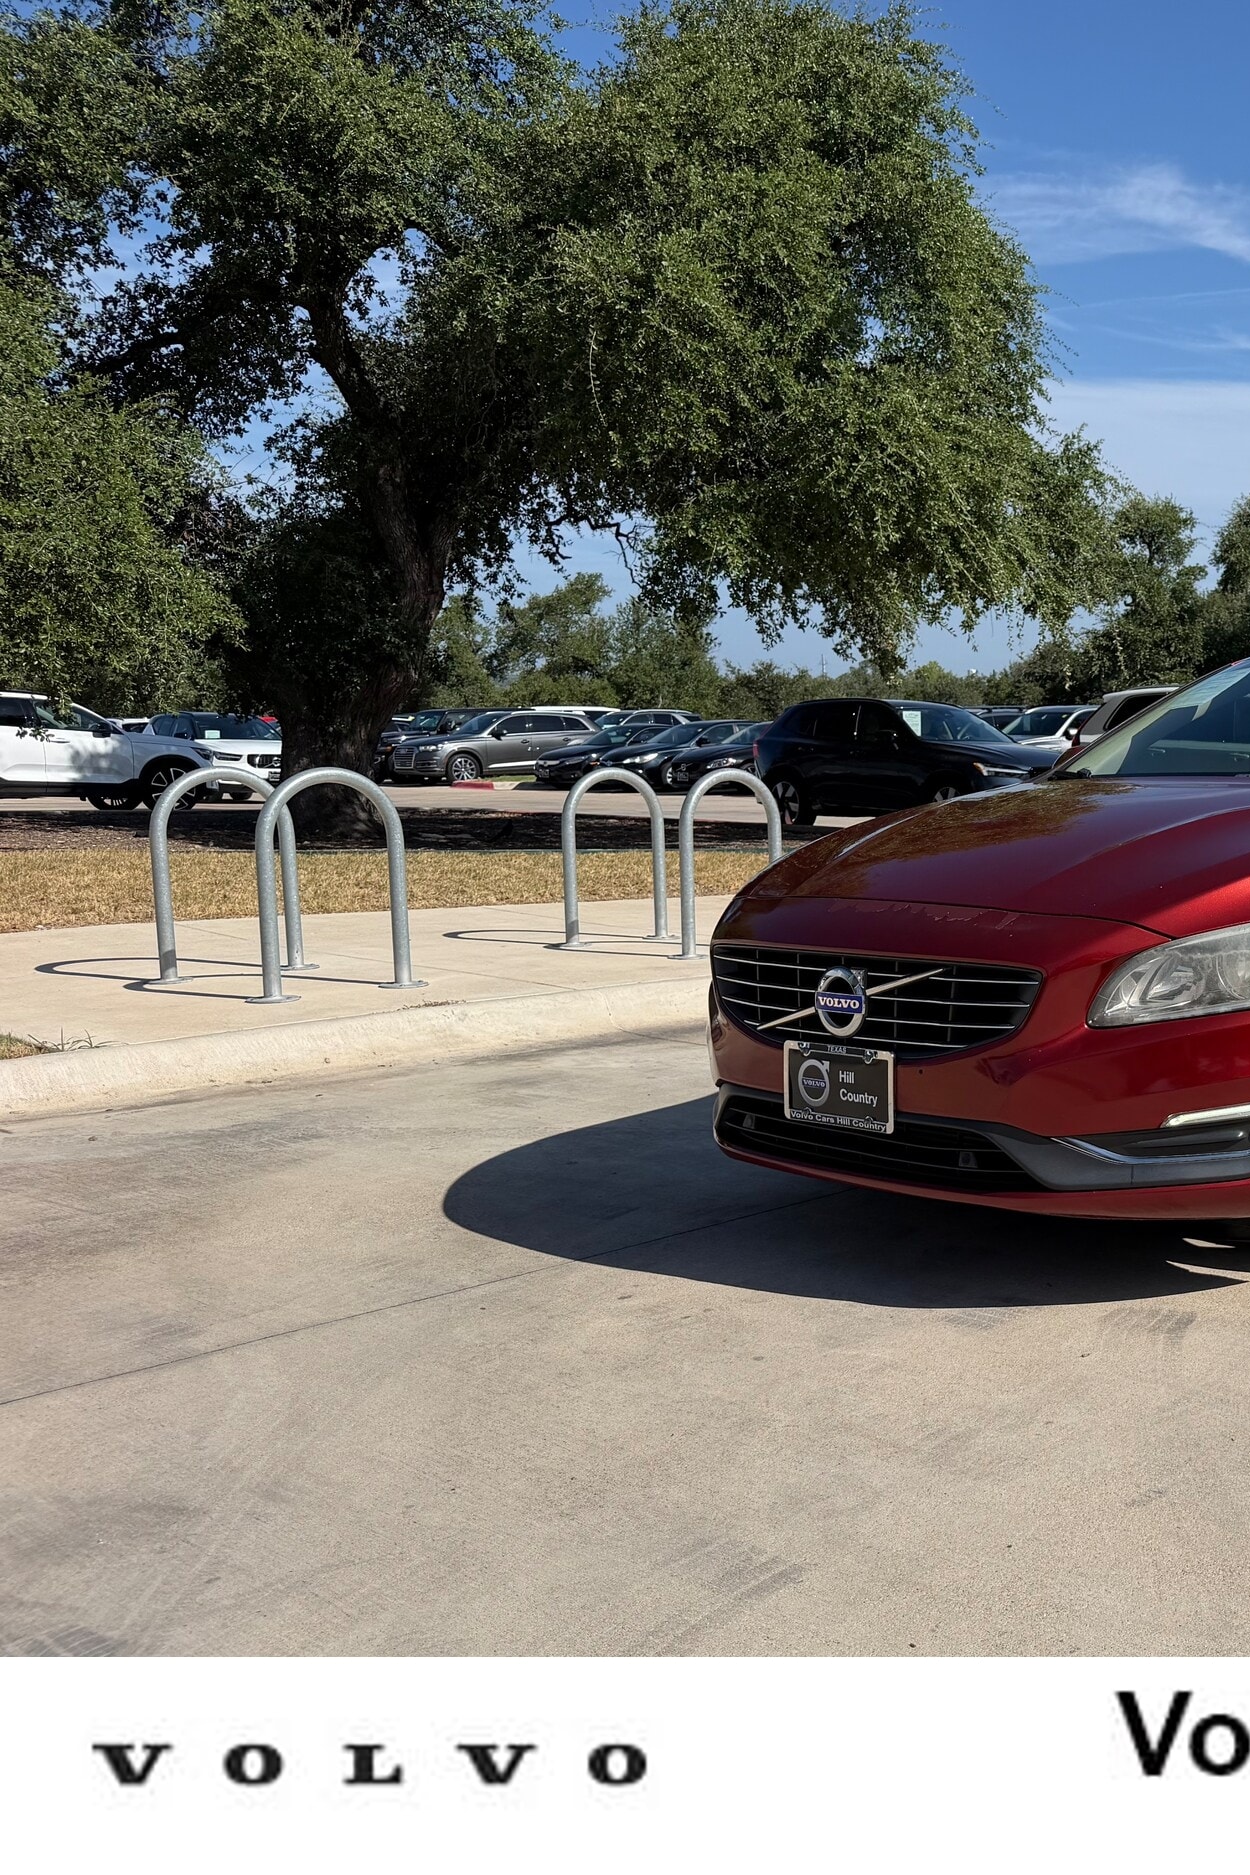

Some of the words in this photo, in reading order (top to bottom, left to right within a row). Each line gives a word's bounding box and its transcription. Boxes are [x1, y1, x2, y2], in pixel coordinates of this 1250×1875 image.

[818, 996, 860, 1009] VOLVO
[826, 1045, 847, 1054] TEXAS
[802, 1079, 826, 1088] VOLVO
[839, 1070, 855, 1084] Hill
[839, 1088, 878, 1107] Country
[790, 1110, 814, 1120] Volvo
[815, 1112, 835, 1124] Cars
[836, 1116, 851, 1126] Hill
[852, 1120, 886, 1132] Country
